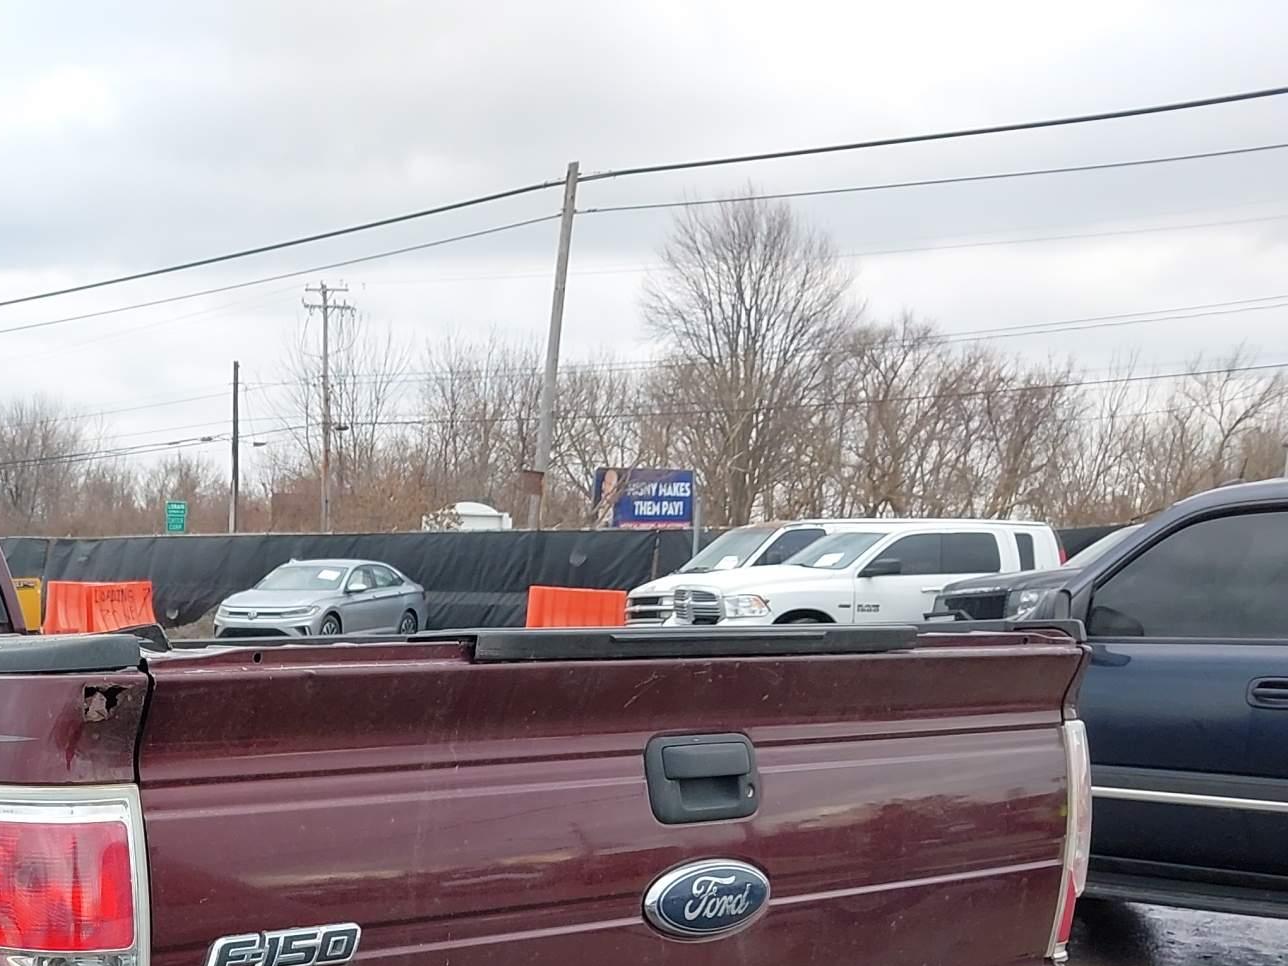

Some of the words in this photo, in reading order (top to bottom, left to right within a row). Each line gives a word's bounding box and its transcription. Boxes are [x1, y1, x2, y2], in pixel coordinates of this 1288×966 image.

[658, 482, 690, 497] MAKES
[635, 501, 660, 516] THEM
[661, 501, 684, 516] PAY!
[683, 874, 754, 921] Ford
